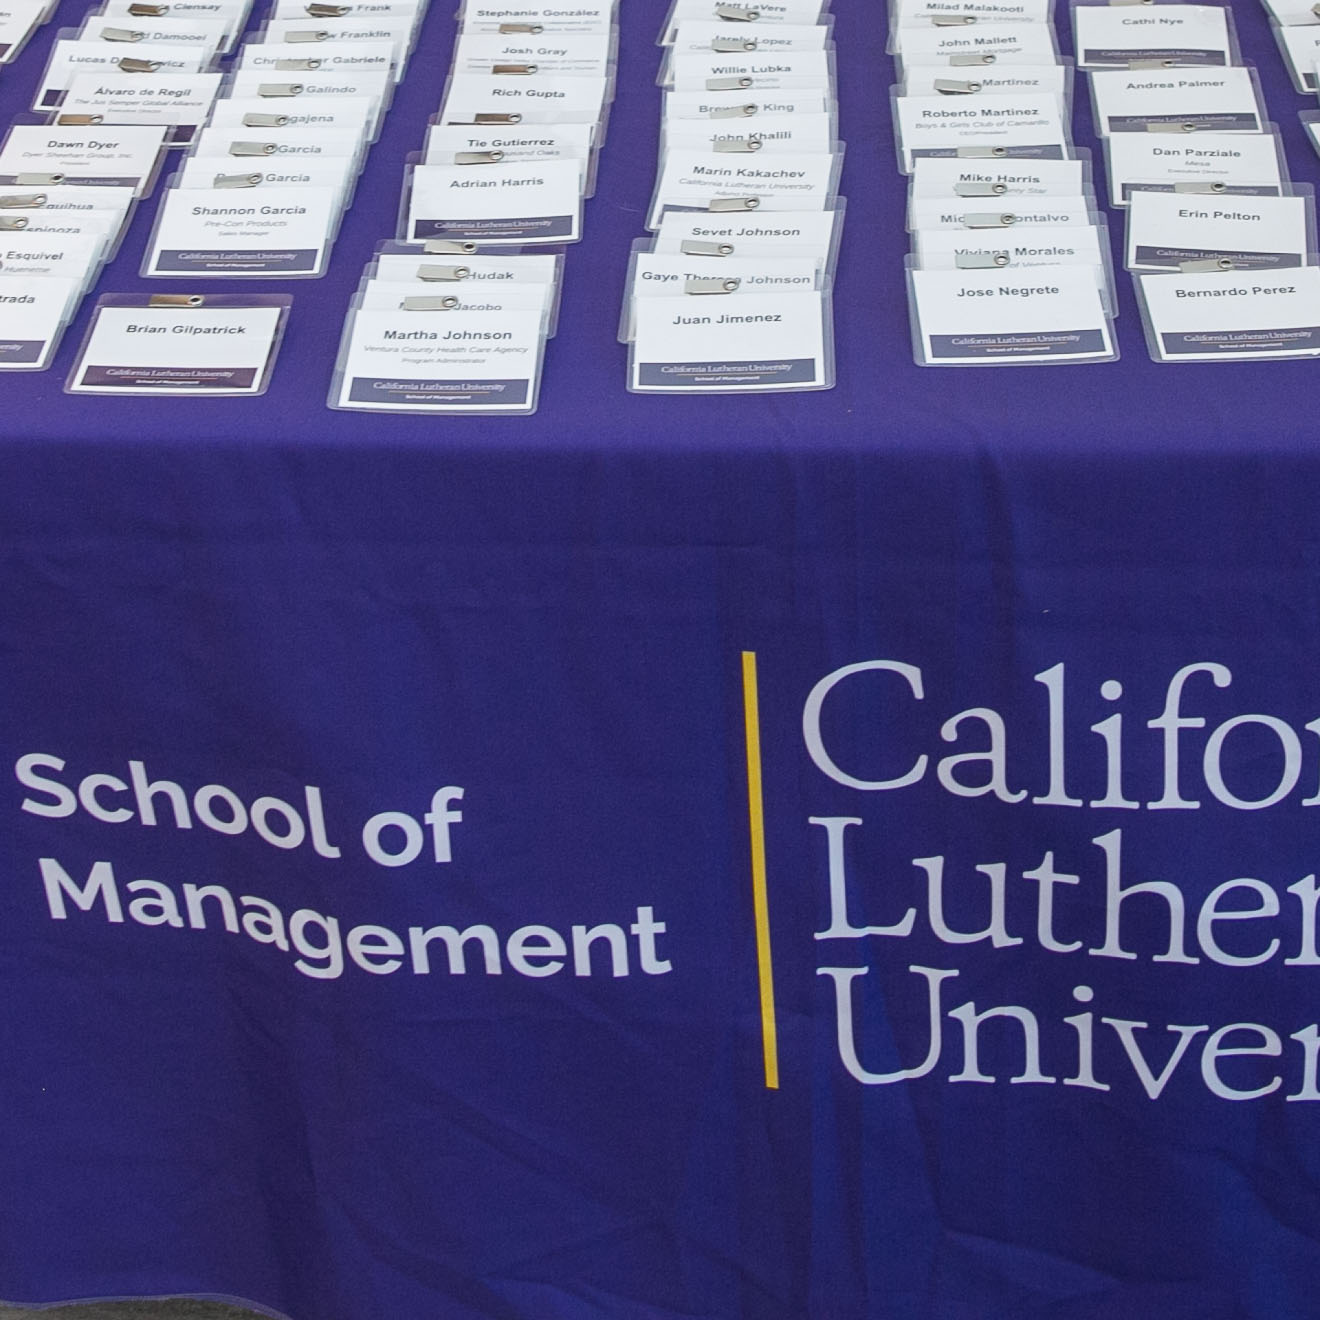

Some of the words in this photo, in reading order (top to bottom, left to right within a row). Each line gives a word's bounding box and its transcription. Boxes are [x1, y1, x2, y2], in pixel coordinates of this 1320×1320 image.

[1122, 18, 1155, 26] Cathi
[1160, 18, 1184, 27] Nye
[501, 47, 533, 55] Josh
[537, 47, 567, 57] Gray
[712, 66, 747, 74] Willie
[752, 65, 791, 73] Lubka
[1127, 81, 1174, 90] Andrea
[1179, 80, 1224, 88] Palmer
[95, 87, 135, 96] Álvaro
[158, 89, 191, 97] Regil
[492, 89, 522, 97] Rich
[526, 90, 565, 98] Gupta
[763, 104, 794, 112] King
[982, 108, 1039, 116] Martinez
[87, 141, 120, 149] Dyer
[492, 138, 555, 147] Gutierrez
[278, 145, 321, 153] Garcia
[693, 166, 731, 176] Marin
[736, 169, 805, 178] Kakachev
[266, 174, 310, 182] Garcia
[450, 179, 496, 188] Adrian
[502, 178, 544, 186] Harris
[960, 174, 992, 182] Mike
[998, 175, 1040, 183] Harris
[192, 206, 255, 215] Shannon
[261, 206, 306, 215] Garcia
[1179, 209, 1208, 218] Erin
[1213, 211, 1260, 221] Pelton
[692, 228, 732, 236] Sevet
[737, 228, 800, 236] Johnson
[6, 251, 63, 261] Esquivel
[1015, 247, 1075, 255] Morales
[642, 272, 678, 282] Gaye
[747, 276, 810, 284] Johnson
[957, 288, 994, 297] Jose
[999, 287, 1059, 297] Negrete
[1176, 286, 1247, 298] Bernardo
[1253, 285, 1296, 295] Perez
[673, 316, 710, 325] Juan
[716, 314, 781, 323] Jimenez
[126, 325, 167, 334] Brian
[172, 326, 246, 335] Gilpatrick
[384, 330, 437, 339] Martha
[443, 331, 512, 340] Johnson
[401, 346, 433, 354] County
[14, 752, 341, 861] School
[361, 787, 463, 867] of
[39, 857, 672, 979] Management
